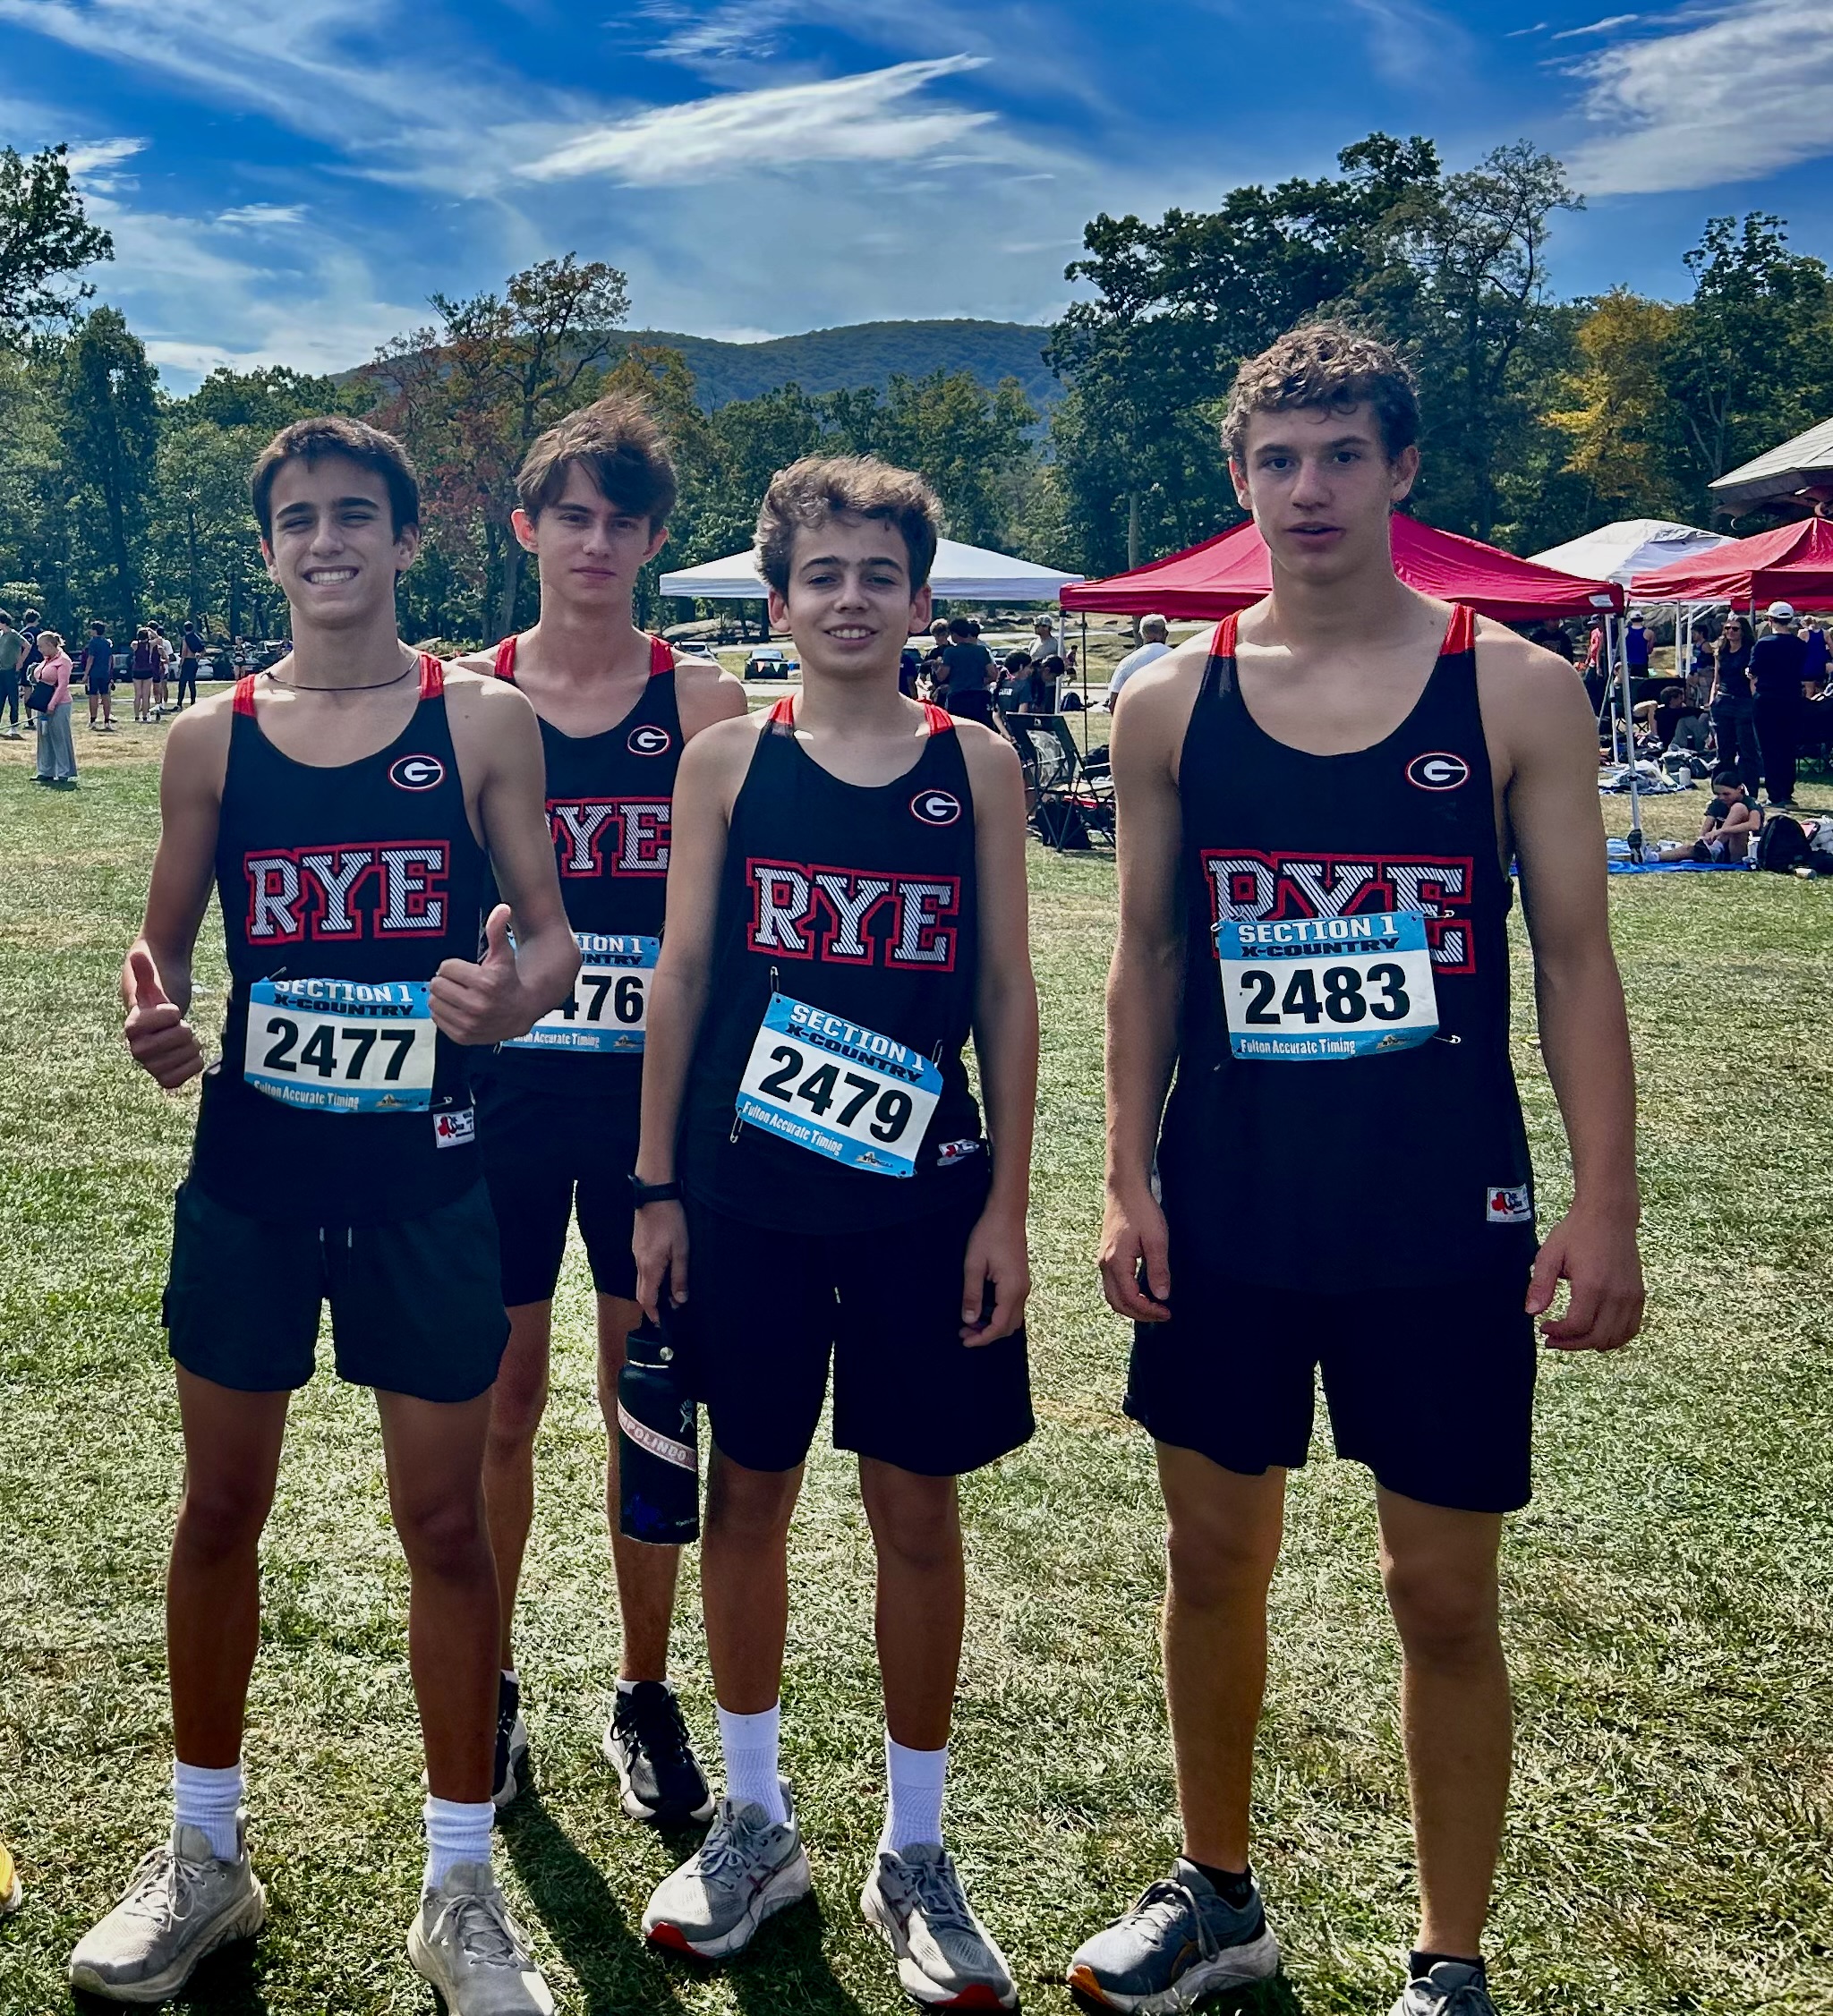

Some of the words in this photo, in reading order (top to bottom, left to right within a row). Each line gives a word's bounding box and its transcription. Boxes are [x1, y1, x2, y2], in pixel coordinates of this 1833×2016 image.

[544, 796, 673, 878] YE
[244, 839, 450, 945] RYE
[746, 856, 961, 972] RYE
[630, 937, 644, 954] 1
[1238, 919, 1372, 944] SECTION
[1379, 915, 1399, 935] 1
[1240, 937, 1400, 958] X-COUNTRY
[274, 992, 414, 1017] X-COUNTRY
[275, 979, 392, 1003] SECTION
[397, 984, 413, 1002] 1
[1240, 962, 1411, 1025] 2483
[263, 1017, 416, 1081] 2477
[785, 1023, 923, 1083] X-COUNTRY
[789, 1002, 906, 1062] SECTION
[912, 1051, 925, 1072] 1
[1240, 1038, 1271, 1054] Fulton
[1272, 1039, 1318, 1055] Accurate
[1318, 1036, 1356, 1056] Timing
[282, 1085, 325, 1105] Accurate
[327, 1092, 360, 1110] Timing
[758, 1045, 913, 1144] 2479
[742, 1100, 772, 1125] Fulton
[770, 1112, 812, 1142] Accurate
[810, 1129, 844, 1157] Timing
